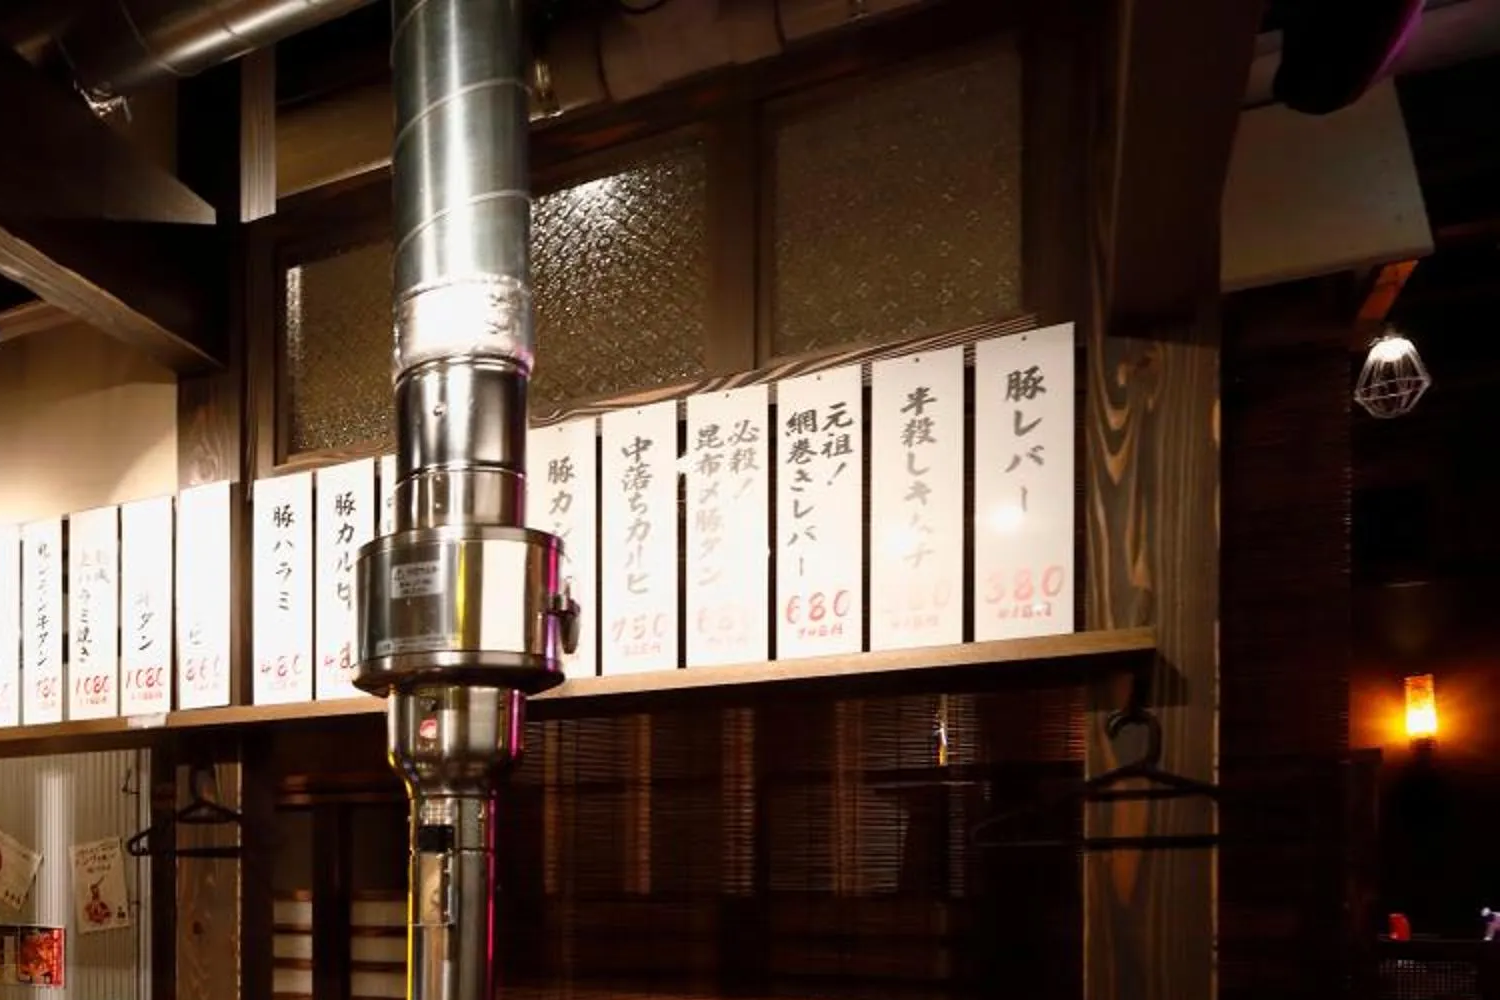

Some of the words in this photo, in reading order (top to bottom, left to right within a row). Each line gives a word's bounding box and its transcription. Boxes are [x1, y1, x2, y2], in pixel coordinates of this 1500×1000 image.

[784, 408, 819, 577] 網巻きレバー
[1004, 366, 1047, 513] 豚レバー
[273, 504, 295, 611] 豚ハラミ
[784, 589, 850, 624] 680
[984, 565, 1065, 605] 380
